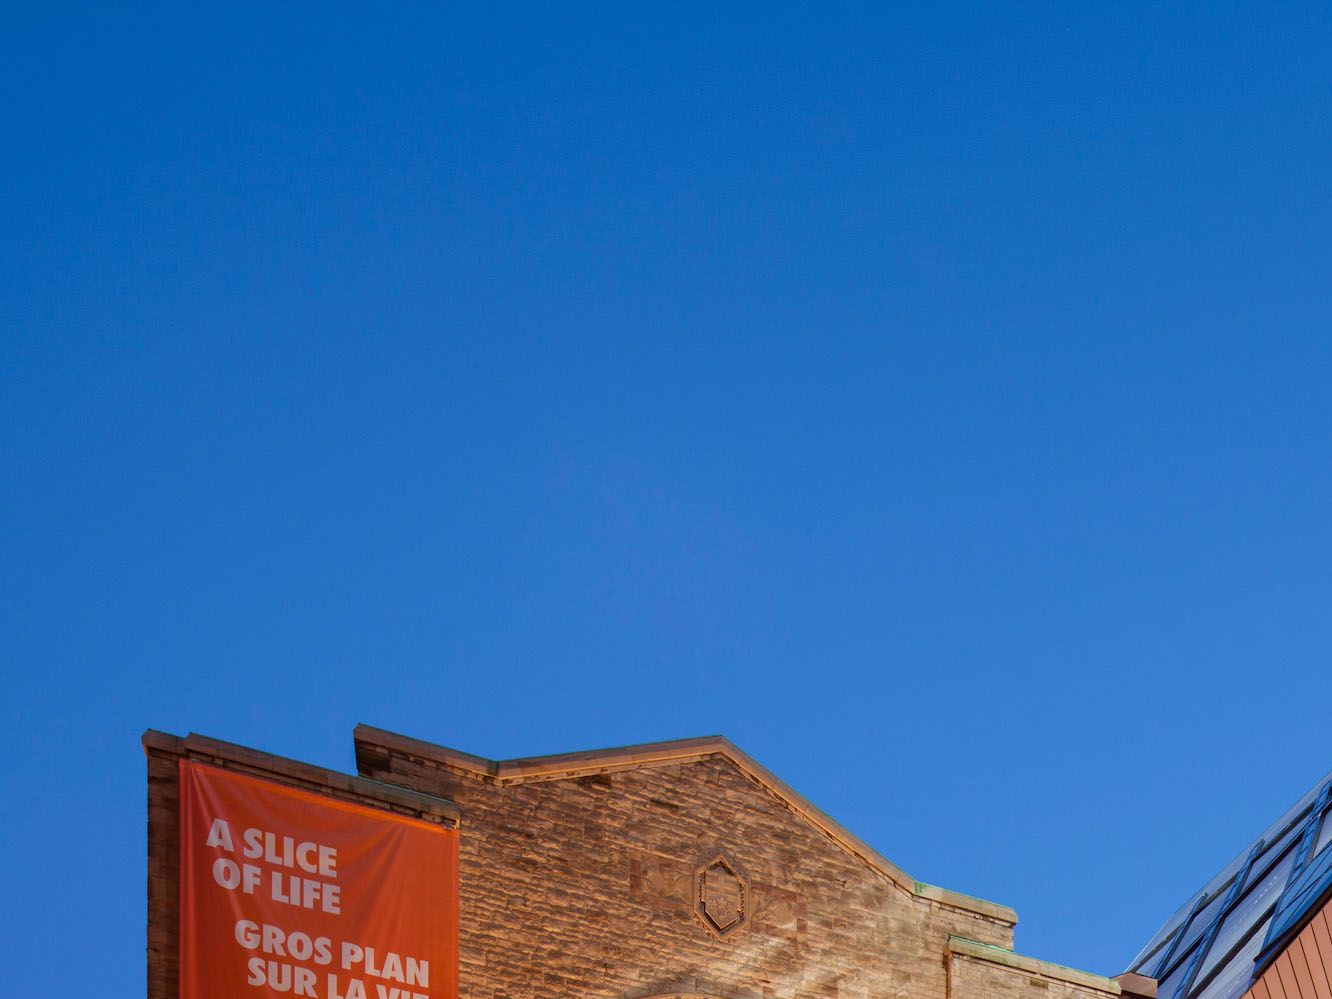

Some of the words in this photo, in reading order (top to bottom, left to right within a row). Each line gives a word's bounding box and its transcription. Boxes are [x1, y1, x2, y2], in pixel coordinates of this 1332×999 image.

[206, 818, 234, 852] A
[243, 828, 337, 878] SLICE
[212, 858, 261, 894] OF
[271, 871, 340, 915] LIFE
[234, 919, 332, 965] GROS
[341, 942, 429, 988] PLAN
[247, 957, 318, 999] SUR
